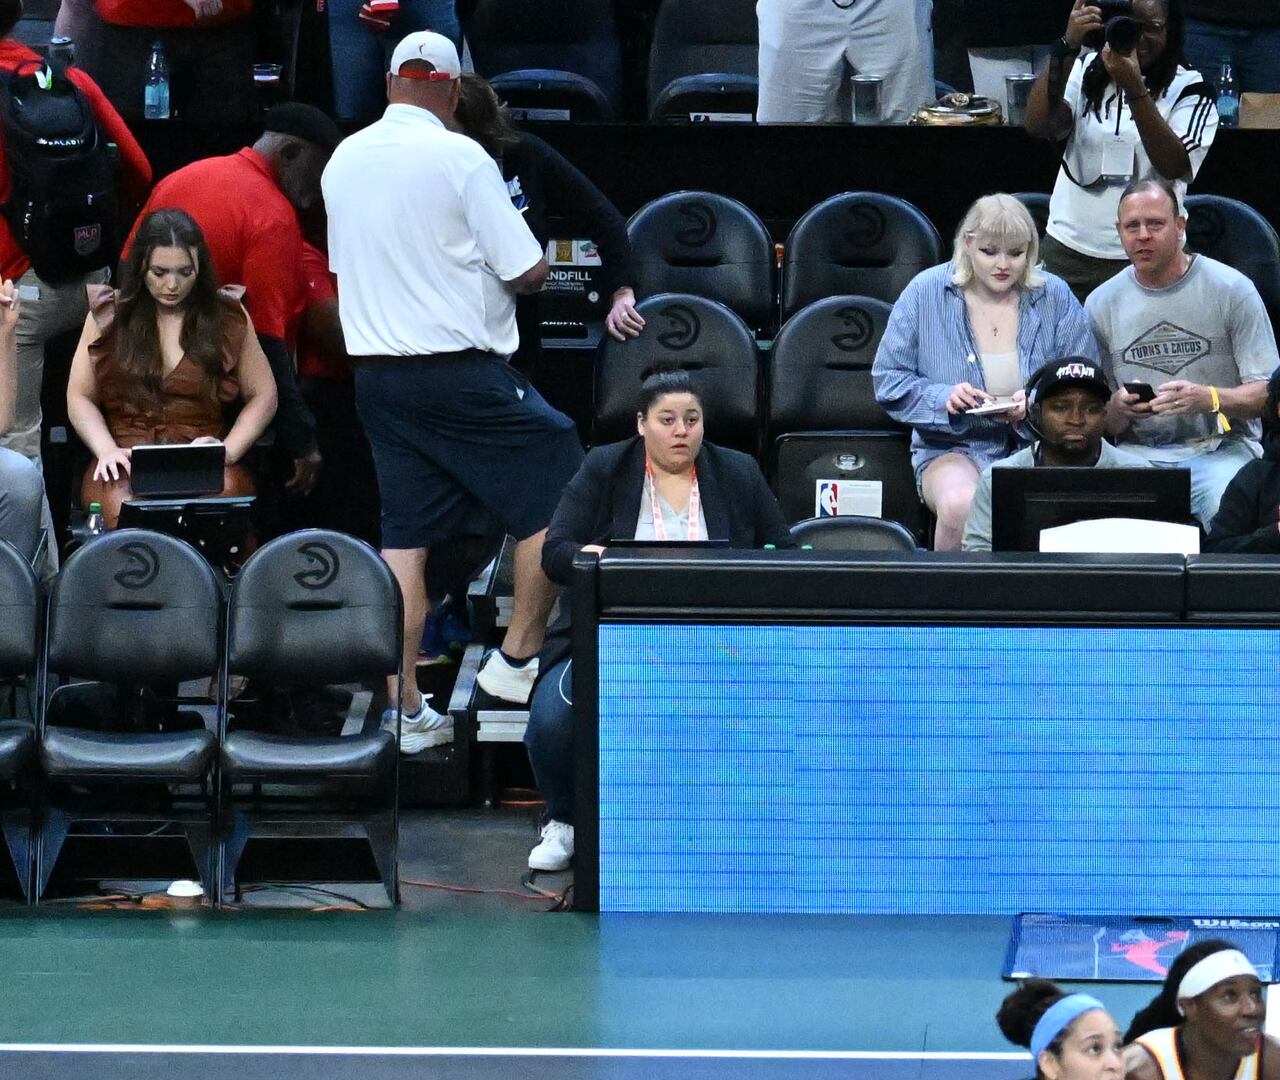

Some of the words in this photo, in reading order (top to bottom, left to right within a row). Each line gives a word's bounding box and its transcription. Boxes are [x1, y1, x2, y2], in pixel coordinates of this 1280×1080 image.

[547, 271, 592, 281] NDFILL
[1131, 343, 1160, 360] TURKS
[1192, 919, 1280, 930] Wilson
